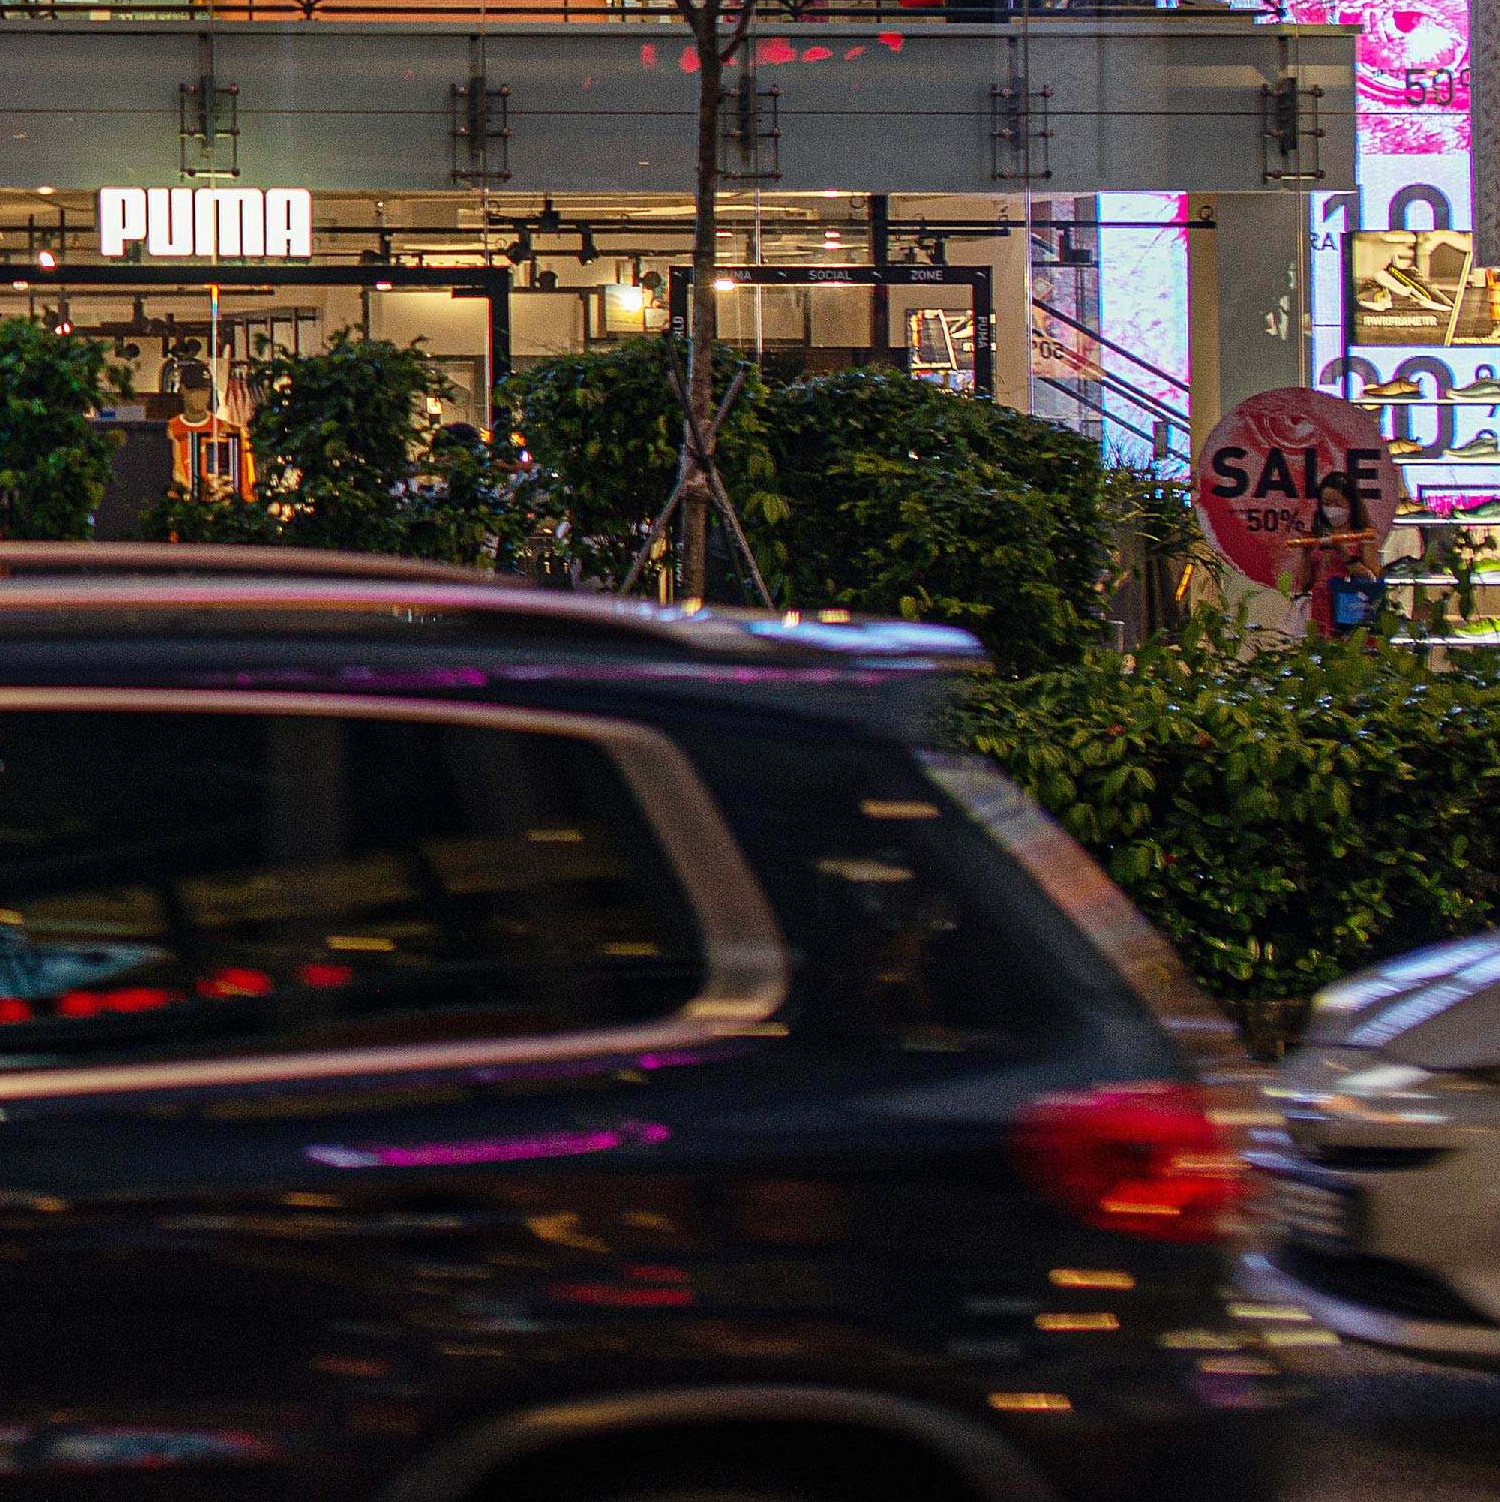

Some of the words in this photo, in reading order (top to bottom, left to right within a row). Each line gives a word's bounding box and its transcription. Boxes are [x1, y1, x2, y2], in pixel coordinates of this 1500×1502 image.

[99, 186, 314, 258] PUMA
[808, 270, 853, 282] SOCIAL
[911, 270, 944, 282] ZONE
[1211, 446, 1384, 500] SALE
[1246, 508, 1305, 533] 50%
